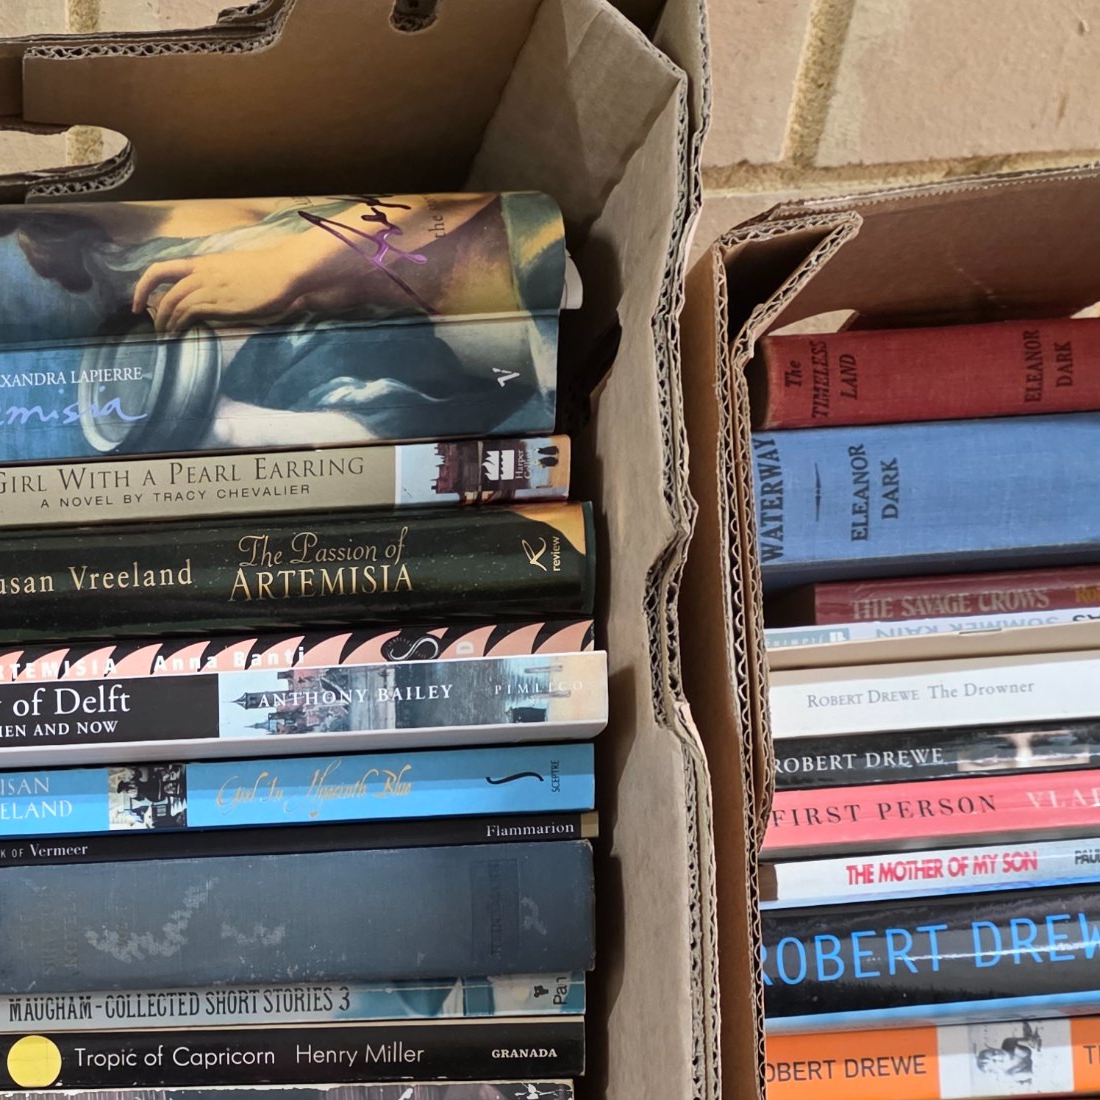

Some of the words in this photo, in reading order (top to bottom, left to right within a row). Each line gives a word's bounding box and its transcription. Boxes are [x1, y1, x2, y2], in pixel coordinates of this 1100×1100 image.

[70, 365, 144, 386] LAPIERRE
[809, 340, 830, 419] TIMELESS
[1022, 328, 1044, 403] ELEANOR
[847, 443, 871, 543] ELEANOR
[879, 456, 900, 521] DARK
[552, 536, 561, 573] review
[67, 558, 194, 592] Vreeland
[228, 563, 415, 603] ARTEMISIA
[12, 687, 44, 718] of
[53, 683, 131, 715] Delft
[258, 688, 368, 709] ANTHONY
[377, 683, 454, 703] BAILEY
[33, 722, 70, 737] AND
[76, 720, 119, 735] NOW
[865, 748, 945, 769] DREWE
[771, 803, 863, 829] FIRST
[877, 794, 997, 822] PERSON
[486, 822, 574, 838] Flammarion
[11, 847, 24, 858] OF
[29, 843, 89, 858] Vermeer
[73, 1048, 138, 1072] Tropic
[144, 1045, 166, 1067] of
[172, 1046, 275, 1070] Capricorn
[295, 1043, 358, 1068] Henry
[365, 1040, 425, 1064] Miller
[491, 1048, 558, 1060] GRANADA
[843, 1054, 928, 1080] DREWE
